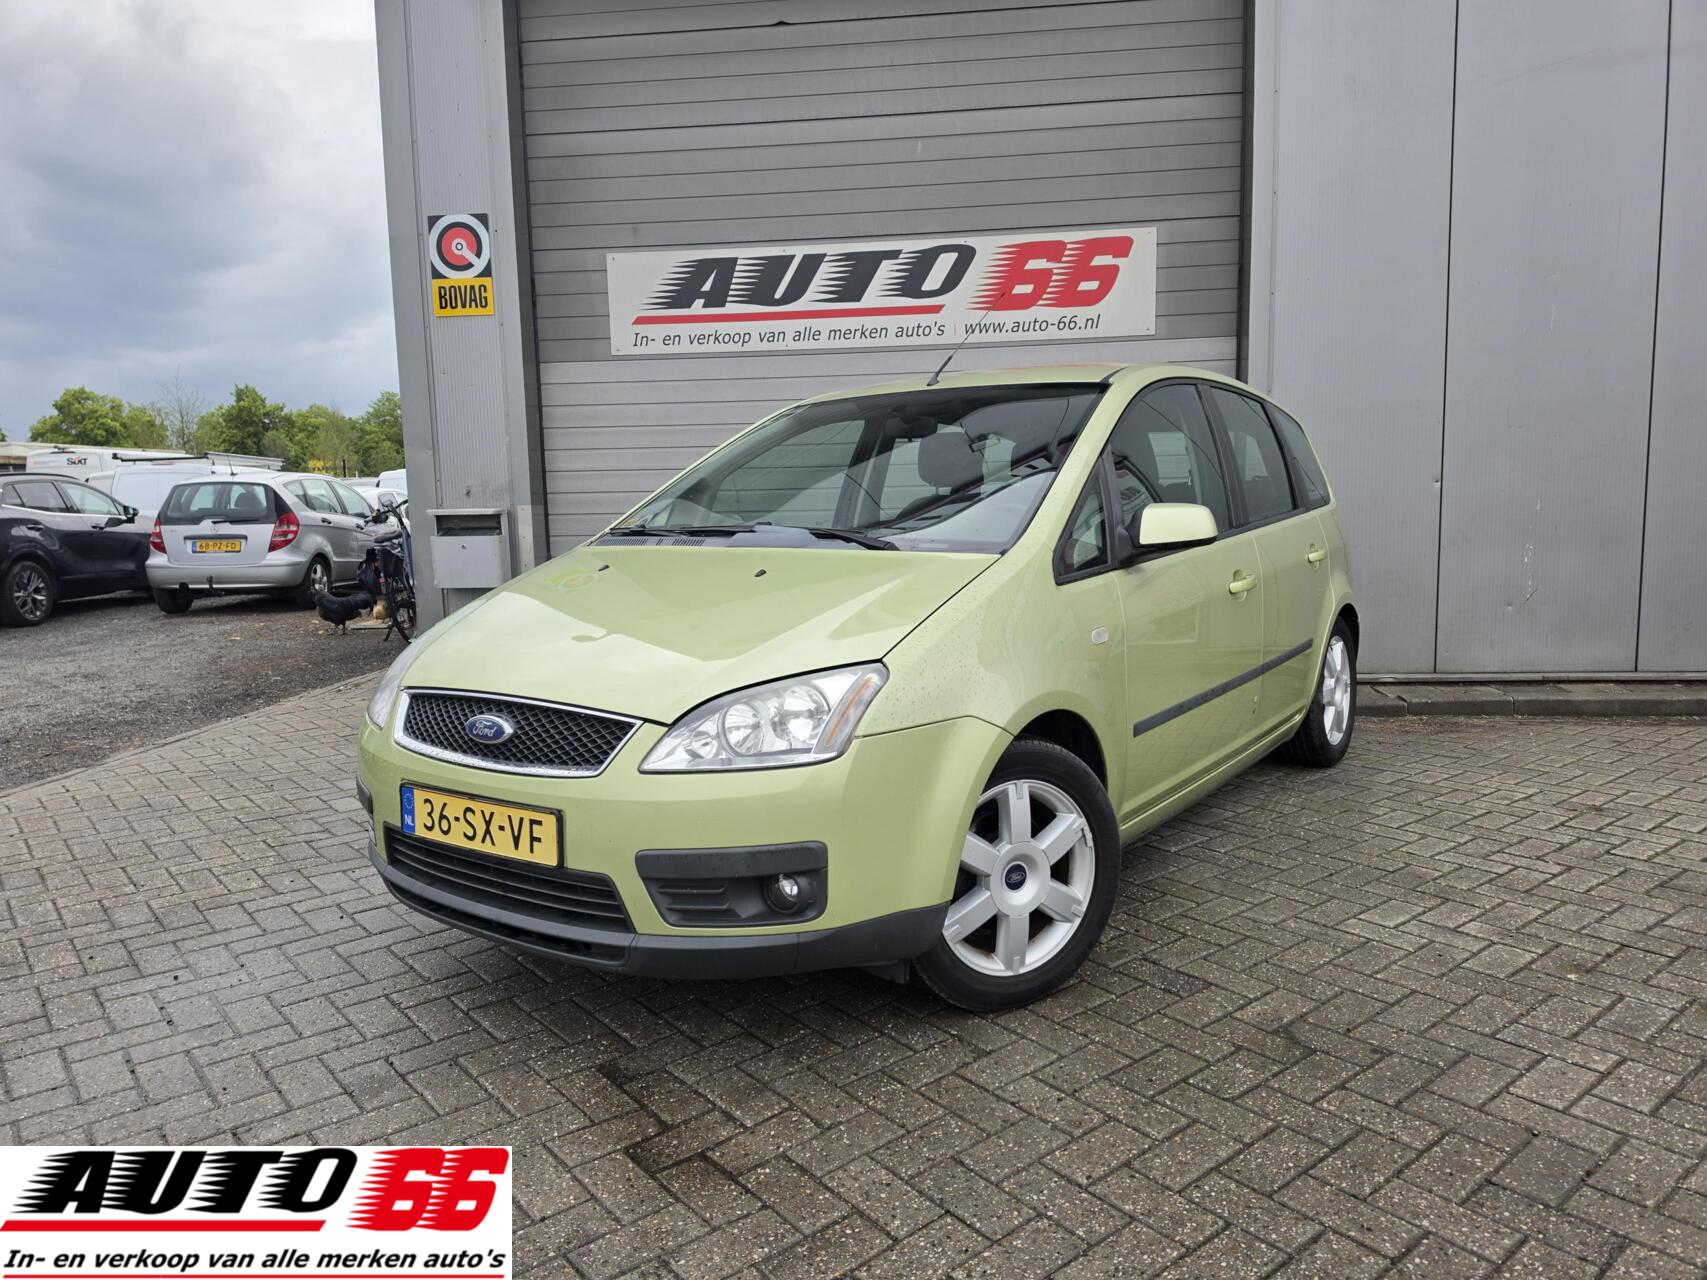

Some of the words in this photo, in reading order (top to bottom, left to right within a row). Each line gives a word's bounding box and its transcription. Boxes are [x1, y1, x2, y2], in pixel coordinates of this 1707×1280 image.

[638, 243, 976, 310] AUTO
[966, 235, 1134, 311] 66
[438, 284, 489, 310] BOVAG
[633, 332, 656, 347] In-
[662, 333, 681, 346] en
[688, 329, 751, 348] verkoop
[758, 329, 786, 343] van
[792, 326, 821, 342] alle
[828, 324, 889, 341] merken
[895, 321, 945, 338] auto's
[964, 313, 1101, 336] www.auto-66.nl
[199, 543, 237, 551] 68-PZ-FD
[472, 720, 498, 737] Ford
[404, 814, 415, 826] NL
[423, 798, 543, 853] 36-SX-VF
